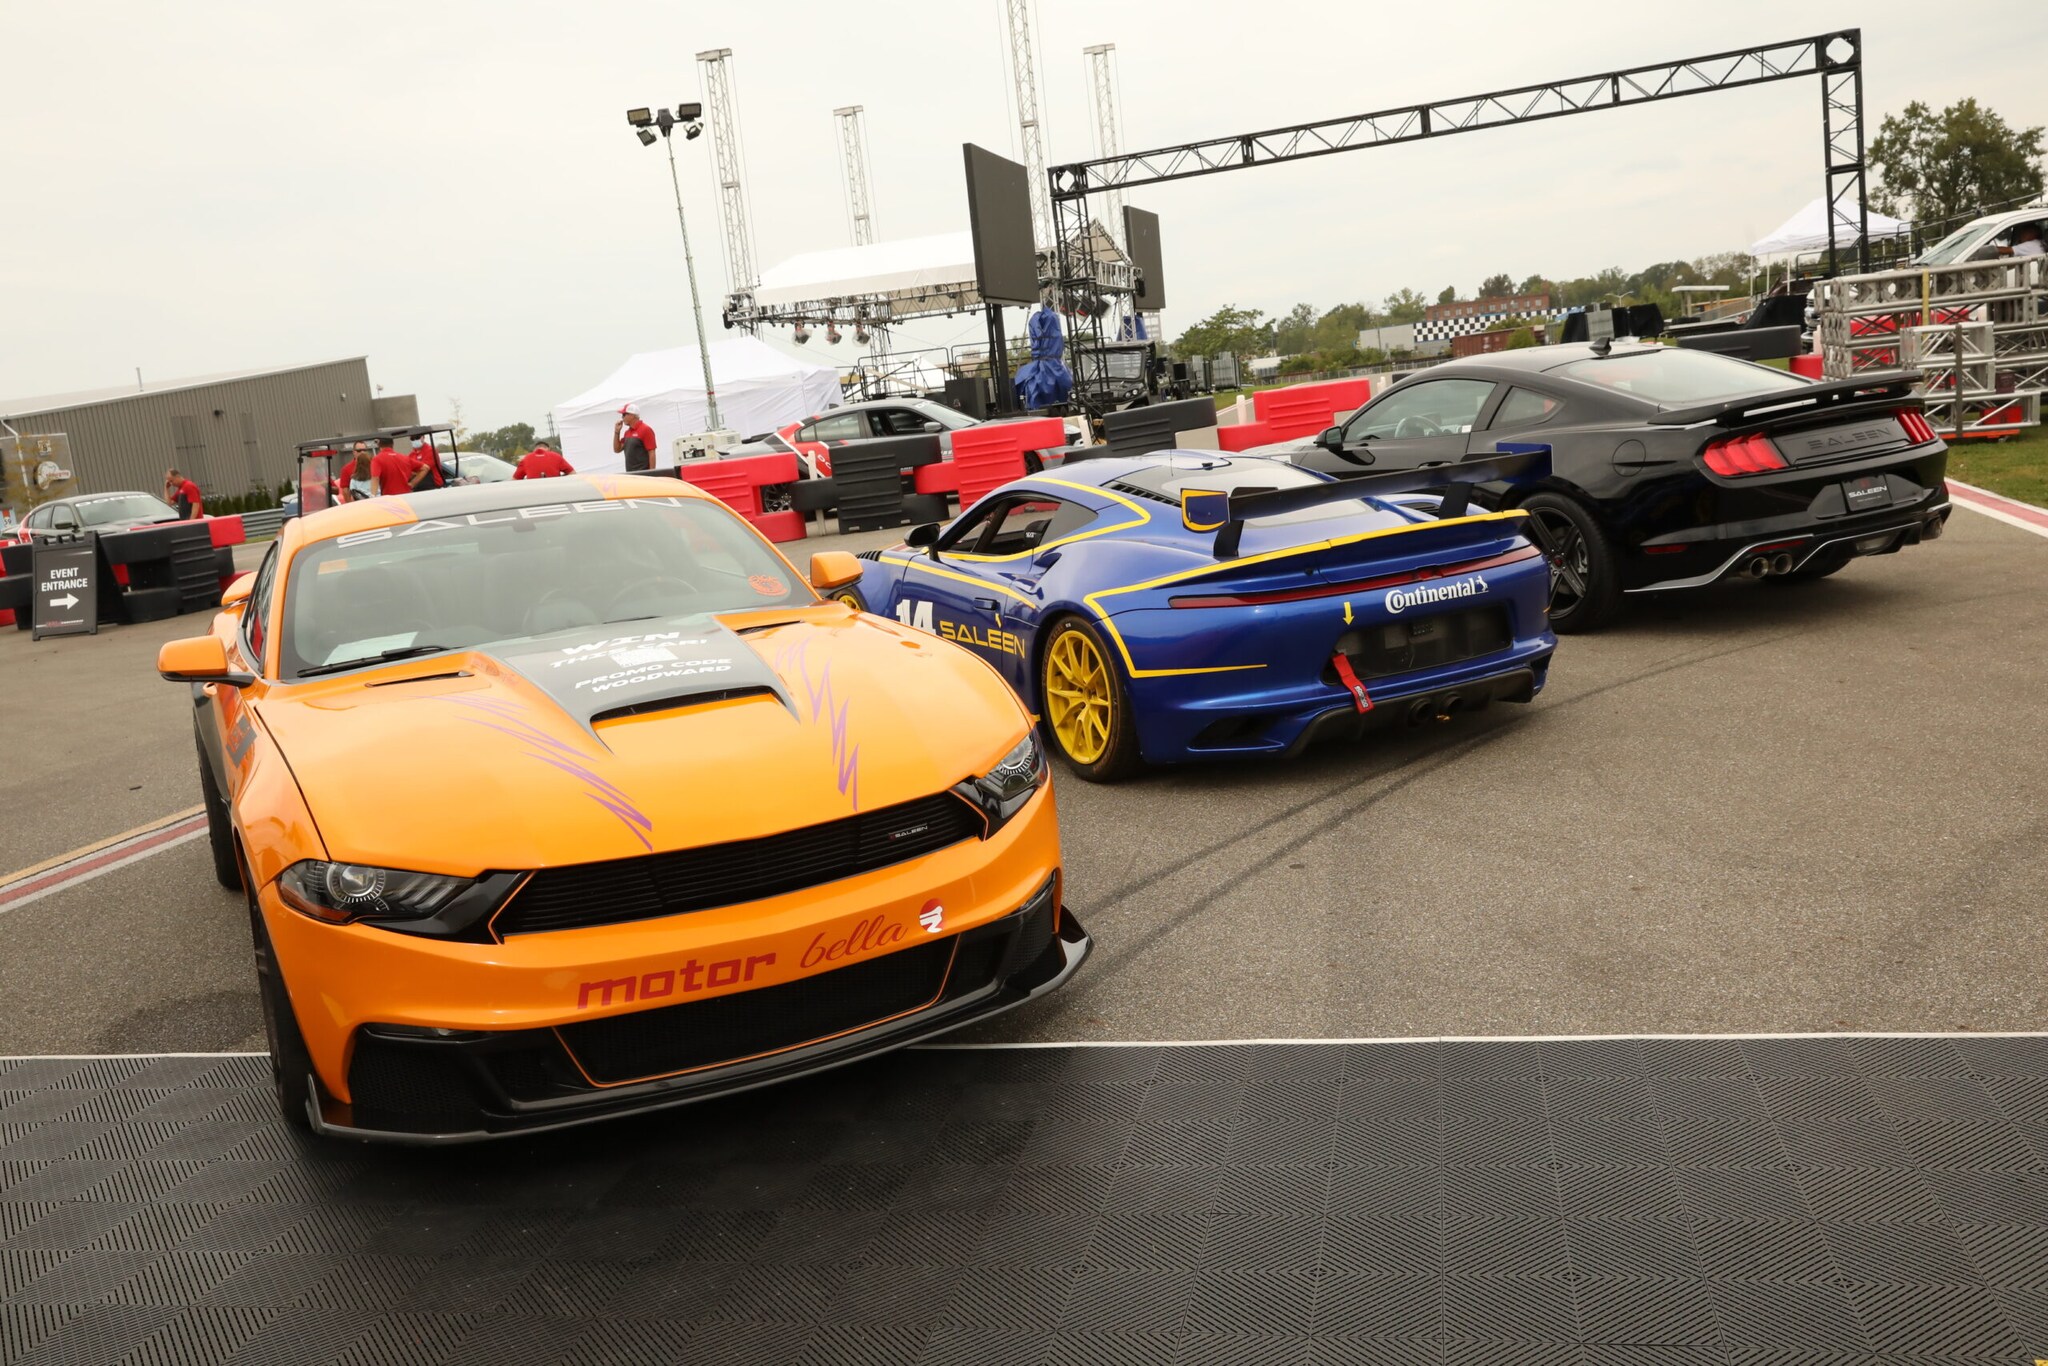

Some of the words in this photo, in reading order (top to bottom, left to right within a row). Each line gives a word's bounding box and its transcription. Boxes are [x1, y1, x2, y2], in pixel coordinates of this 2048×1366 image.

[1808, 427, 1890, 450] SALEEN
[1848, 485, 1887, 498] SALEEN
[337, 497, 683, 549] SALEEN
[41, 578, 88, 592] ENTRANCE
[50, 567, 79, 579] EVENT
[1385, 578, 1476, 614] Continental
[562, 632, 680, 655] WIN
[940, 620, 1025, 658] SALEEN
[574, 663, 664, 689] PROMO
[671, 658, 732, 669] CODE
[592, 665, 732, 693] WOODWARD
[895, 825, 928, 838] SALEEN
[577, 953, 776, 1009] motor
[800, 914, 908, 969] bella
